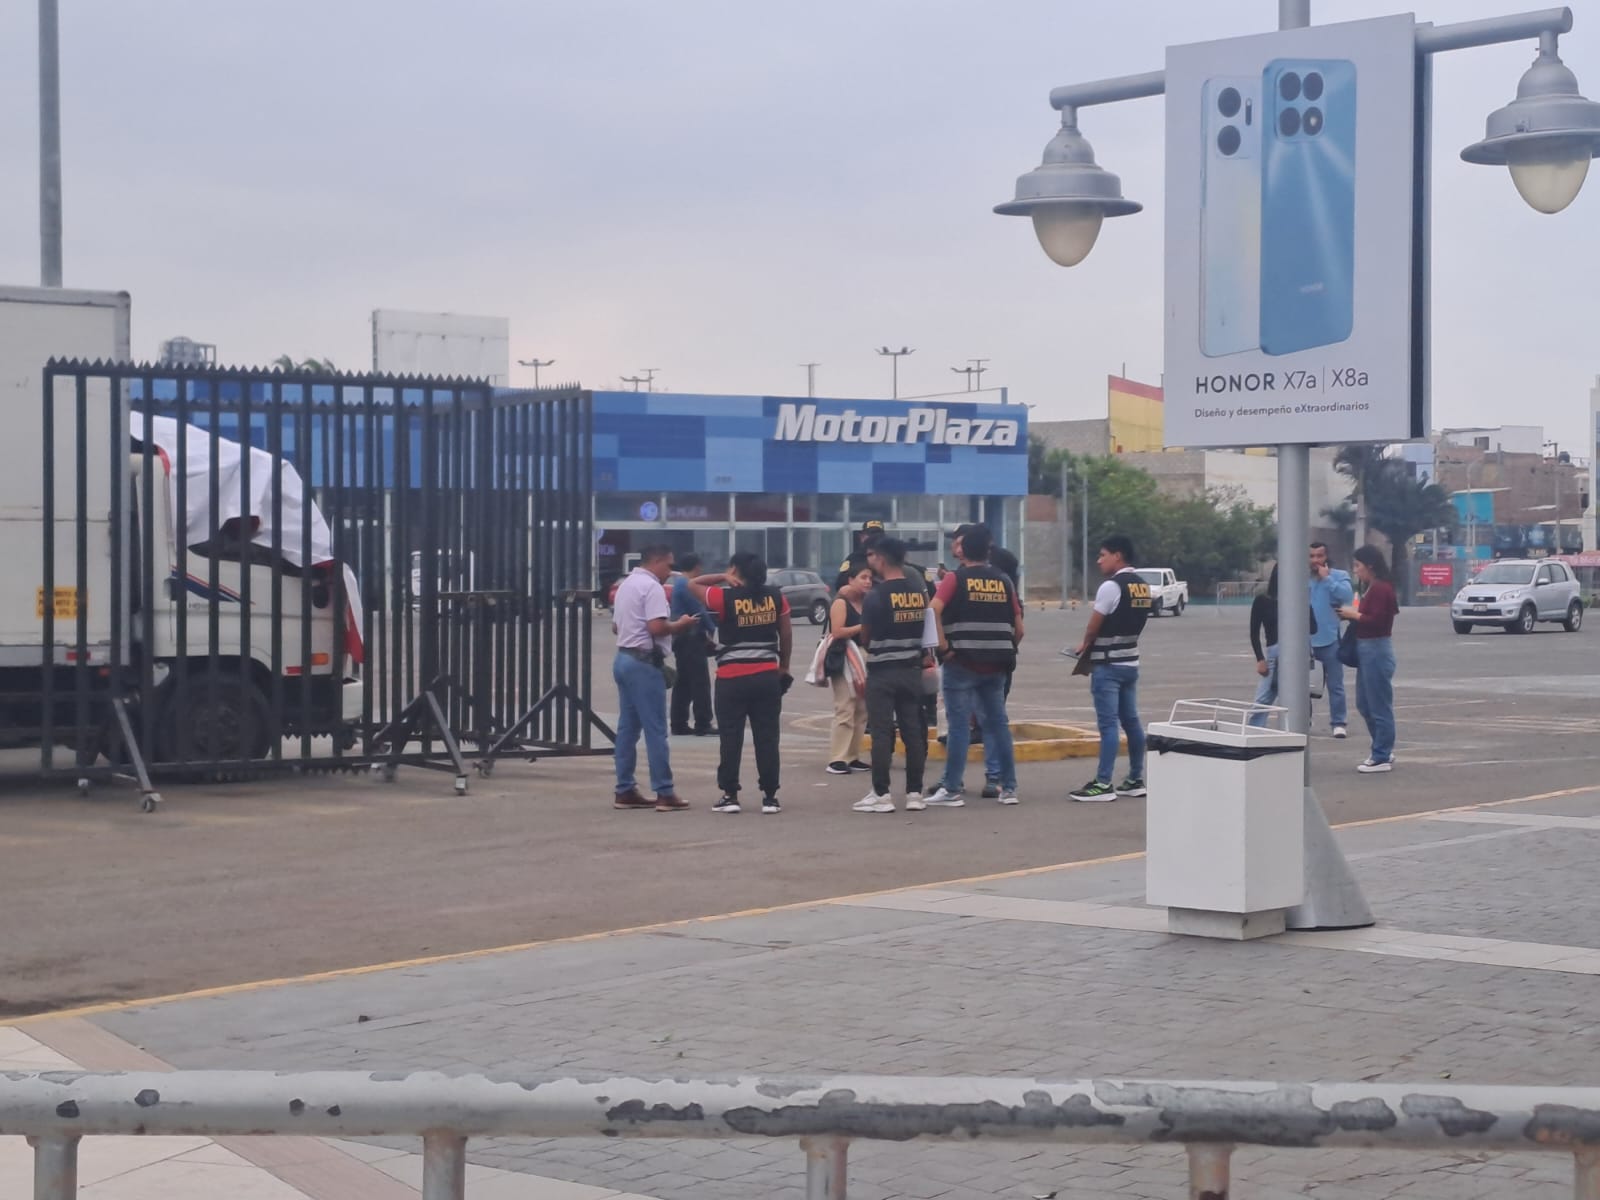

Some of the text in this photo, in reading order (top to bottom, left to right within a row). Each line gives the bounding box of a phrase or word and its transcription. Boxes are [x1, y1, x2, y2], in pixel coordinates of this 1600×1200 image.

[1196, 368, 1369, 394] HONOR X7a X8a
[1194, 406, 1226, 418] Diseño
[1236, 404, 1292, 417] desempeño
[1294, 401, 1369, 414] eXtraordinarios
[774, 404, 1018, 447] MotorPlaza
[967, 578, 1006, 593] POLICIA
[890, 592, 925, 608] POLICIA
